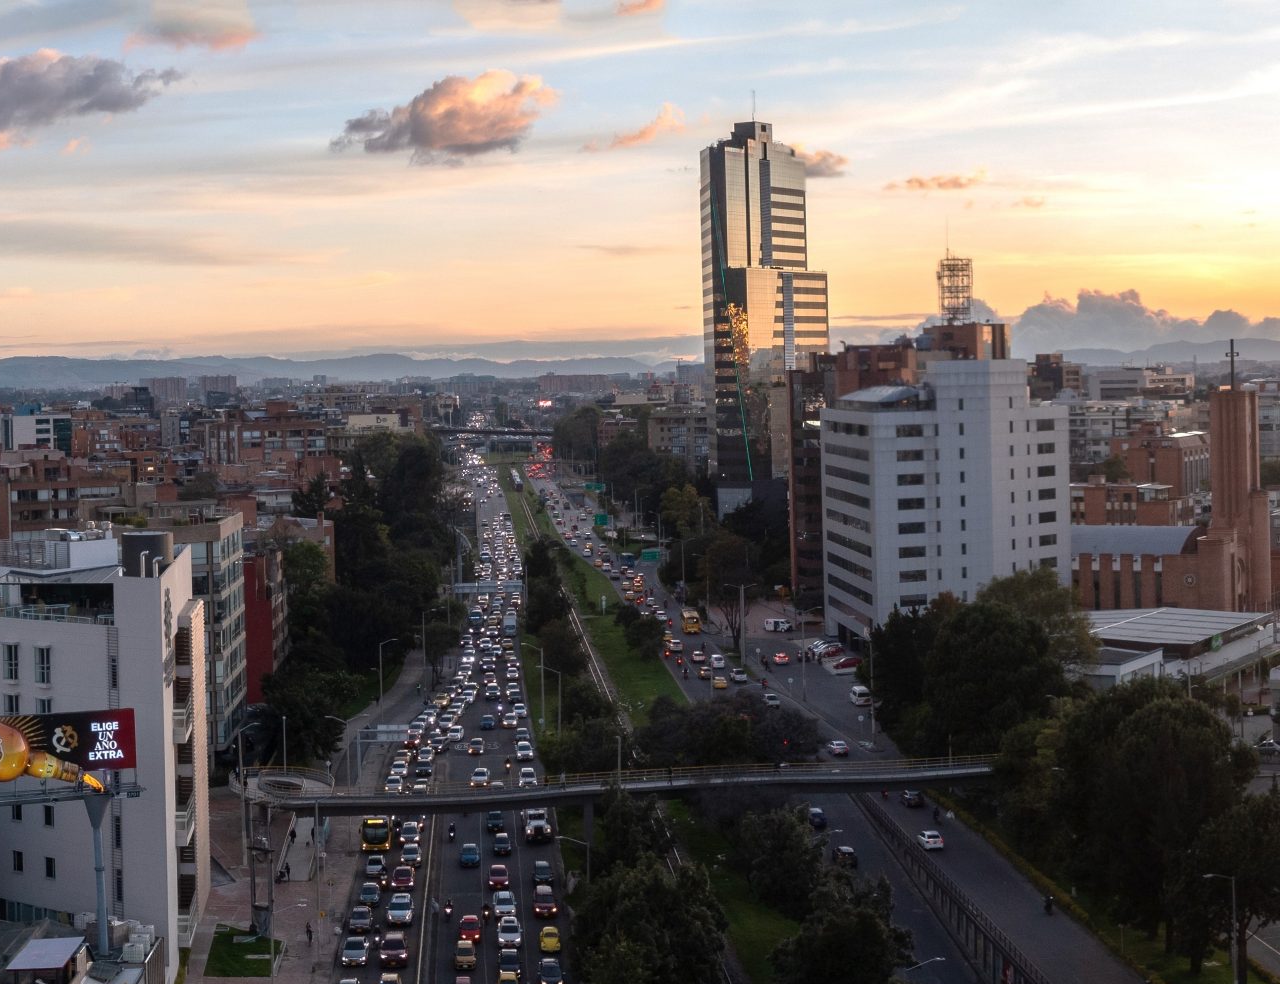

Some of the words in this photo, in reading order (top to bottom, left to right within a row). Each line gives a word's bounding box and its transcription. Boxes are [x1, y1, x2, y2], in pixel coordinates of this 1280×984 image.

[91, 721, 120, 732] ELIGE
[98, 731, 115, 741] UN
[94, 738, 118, 751] AÑO
[88, 749, 125, 761] EXTRA
